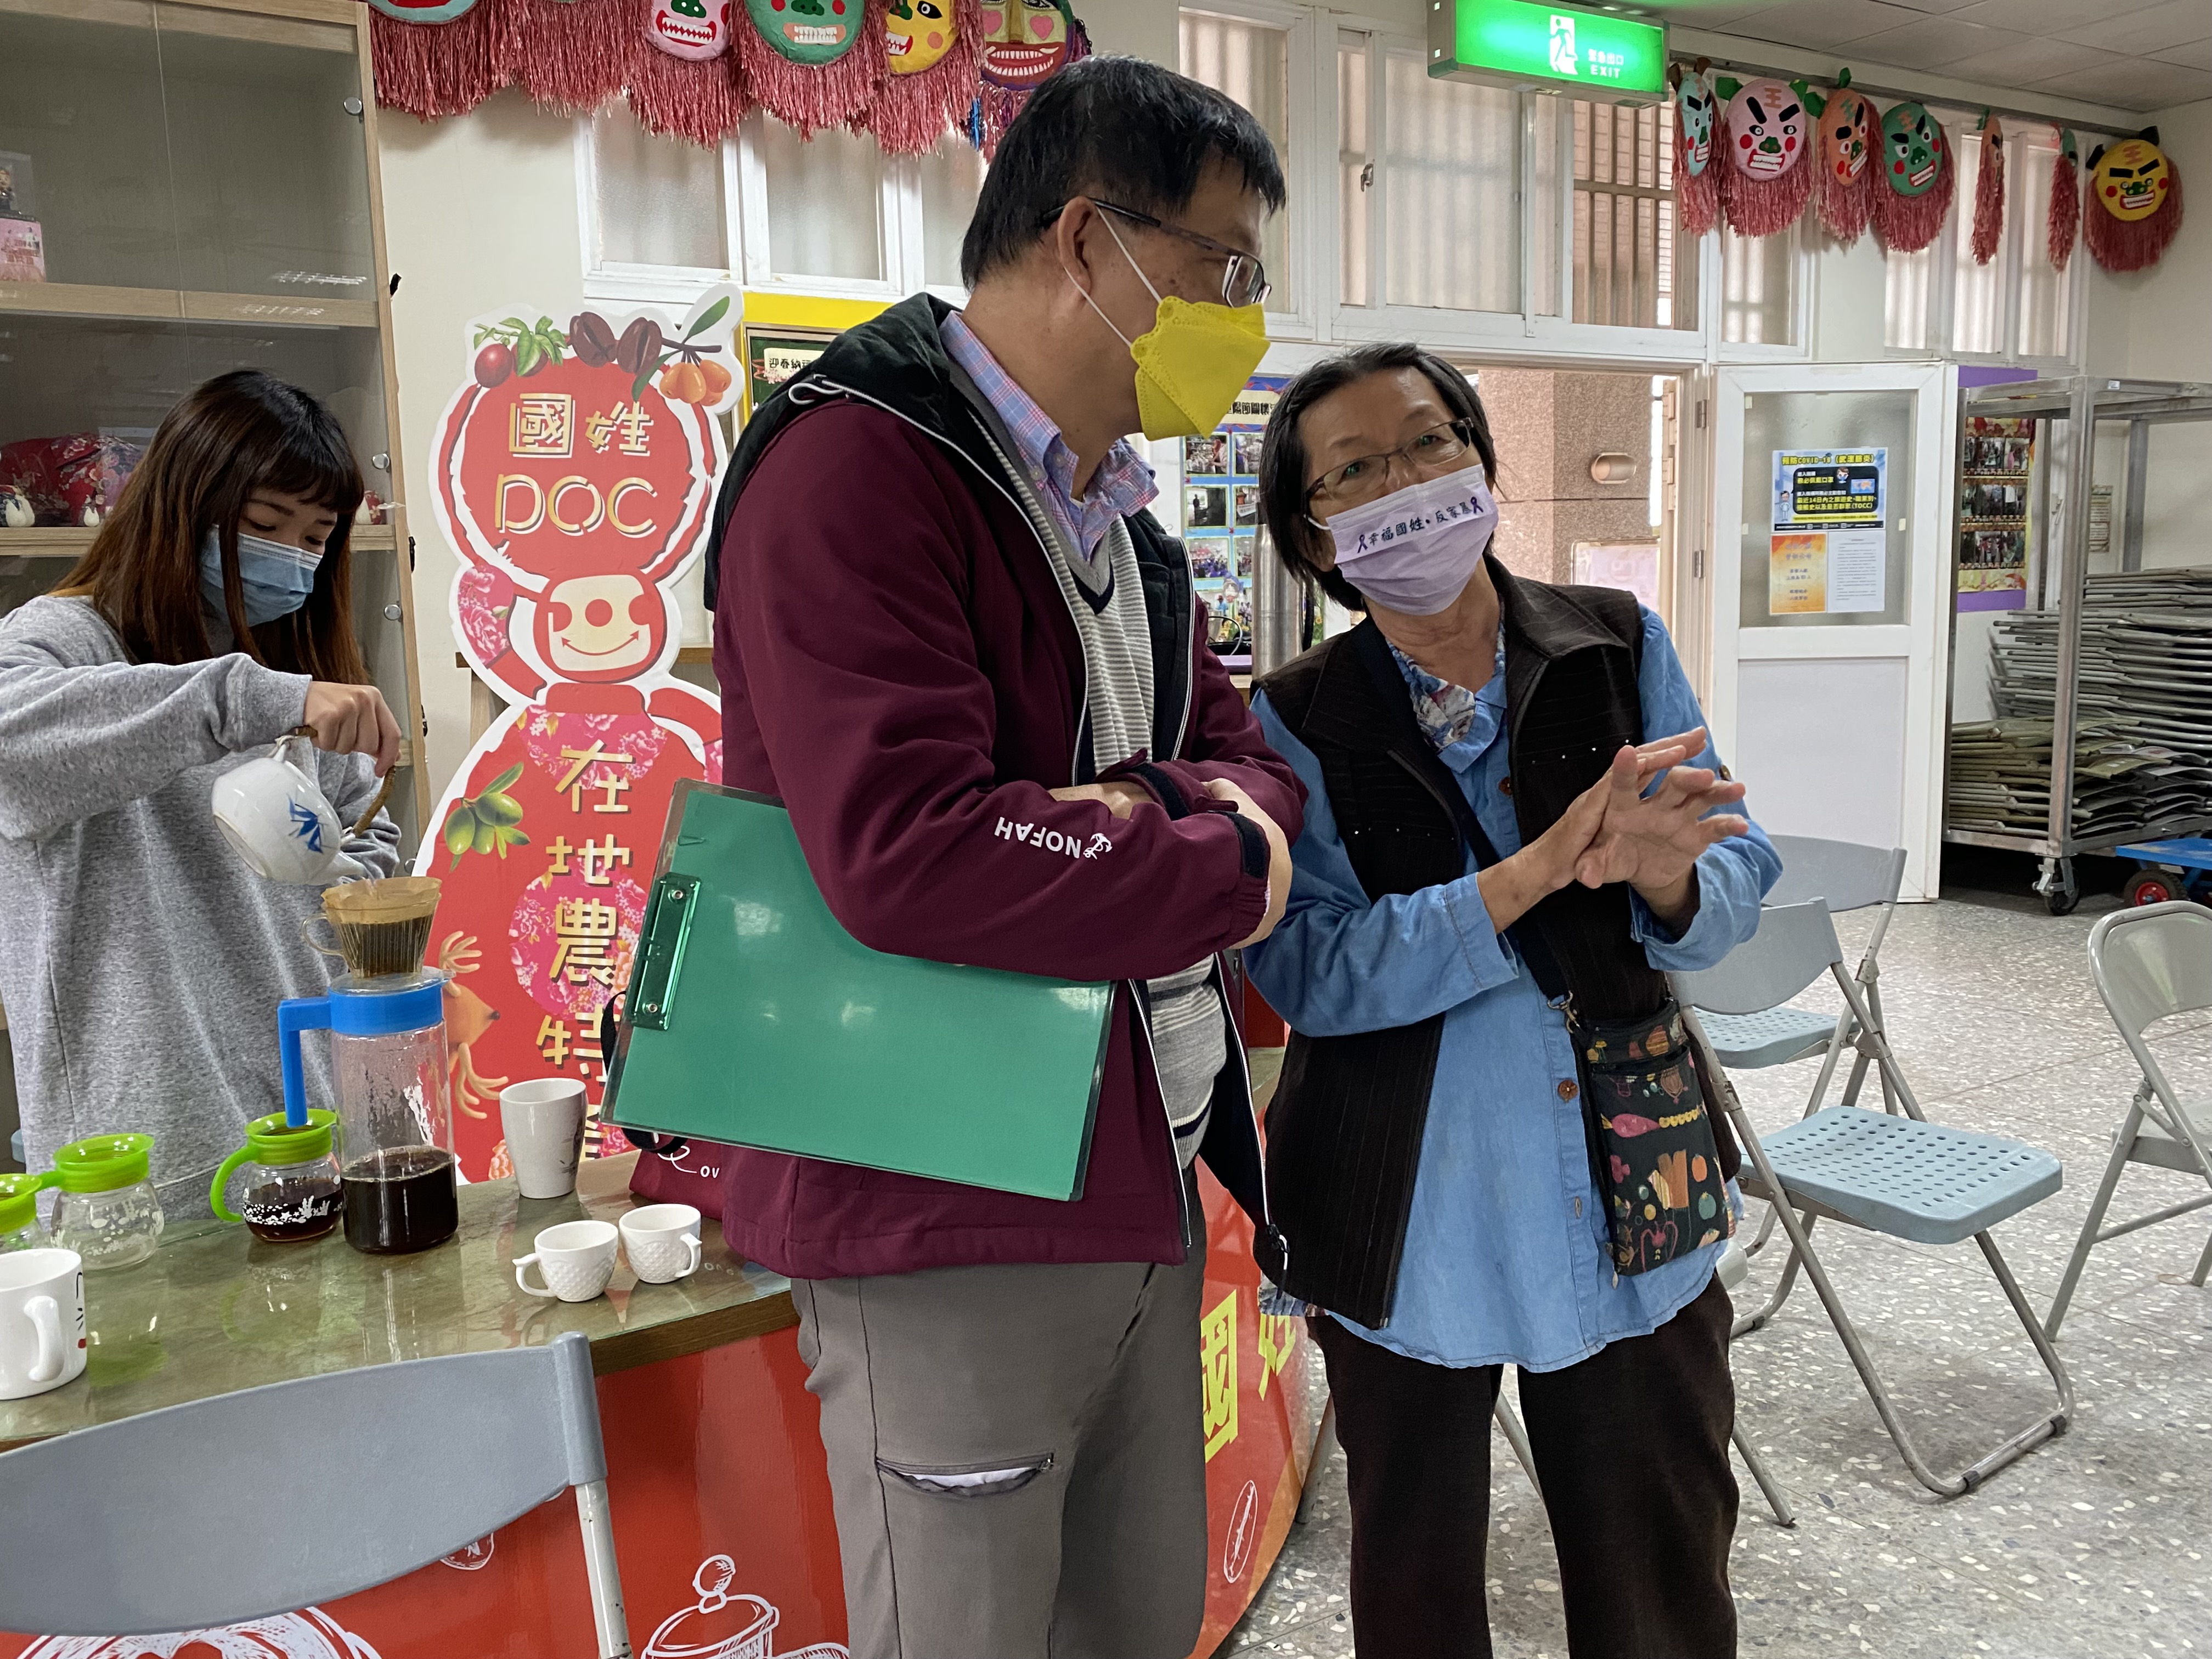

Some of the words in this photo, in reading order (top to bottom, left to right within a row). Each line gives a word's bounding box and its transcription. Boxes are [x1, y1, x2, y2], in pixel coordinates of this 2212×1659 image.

[1590, 64, 1621, 78] EXIT
[509, 393, 654, 459] 國姓
[494, 474, 658, 539] DOC
[994, 816, 1081, 859] NOFAH
[535, 739, 635, 1163] 在地農特
